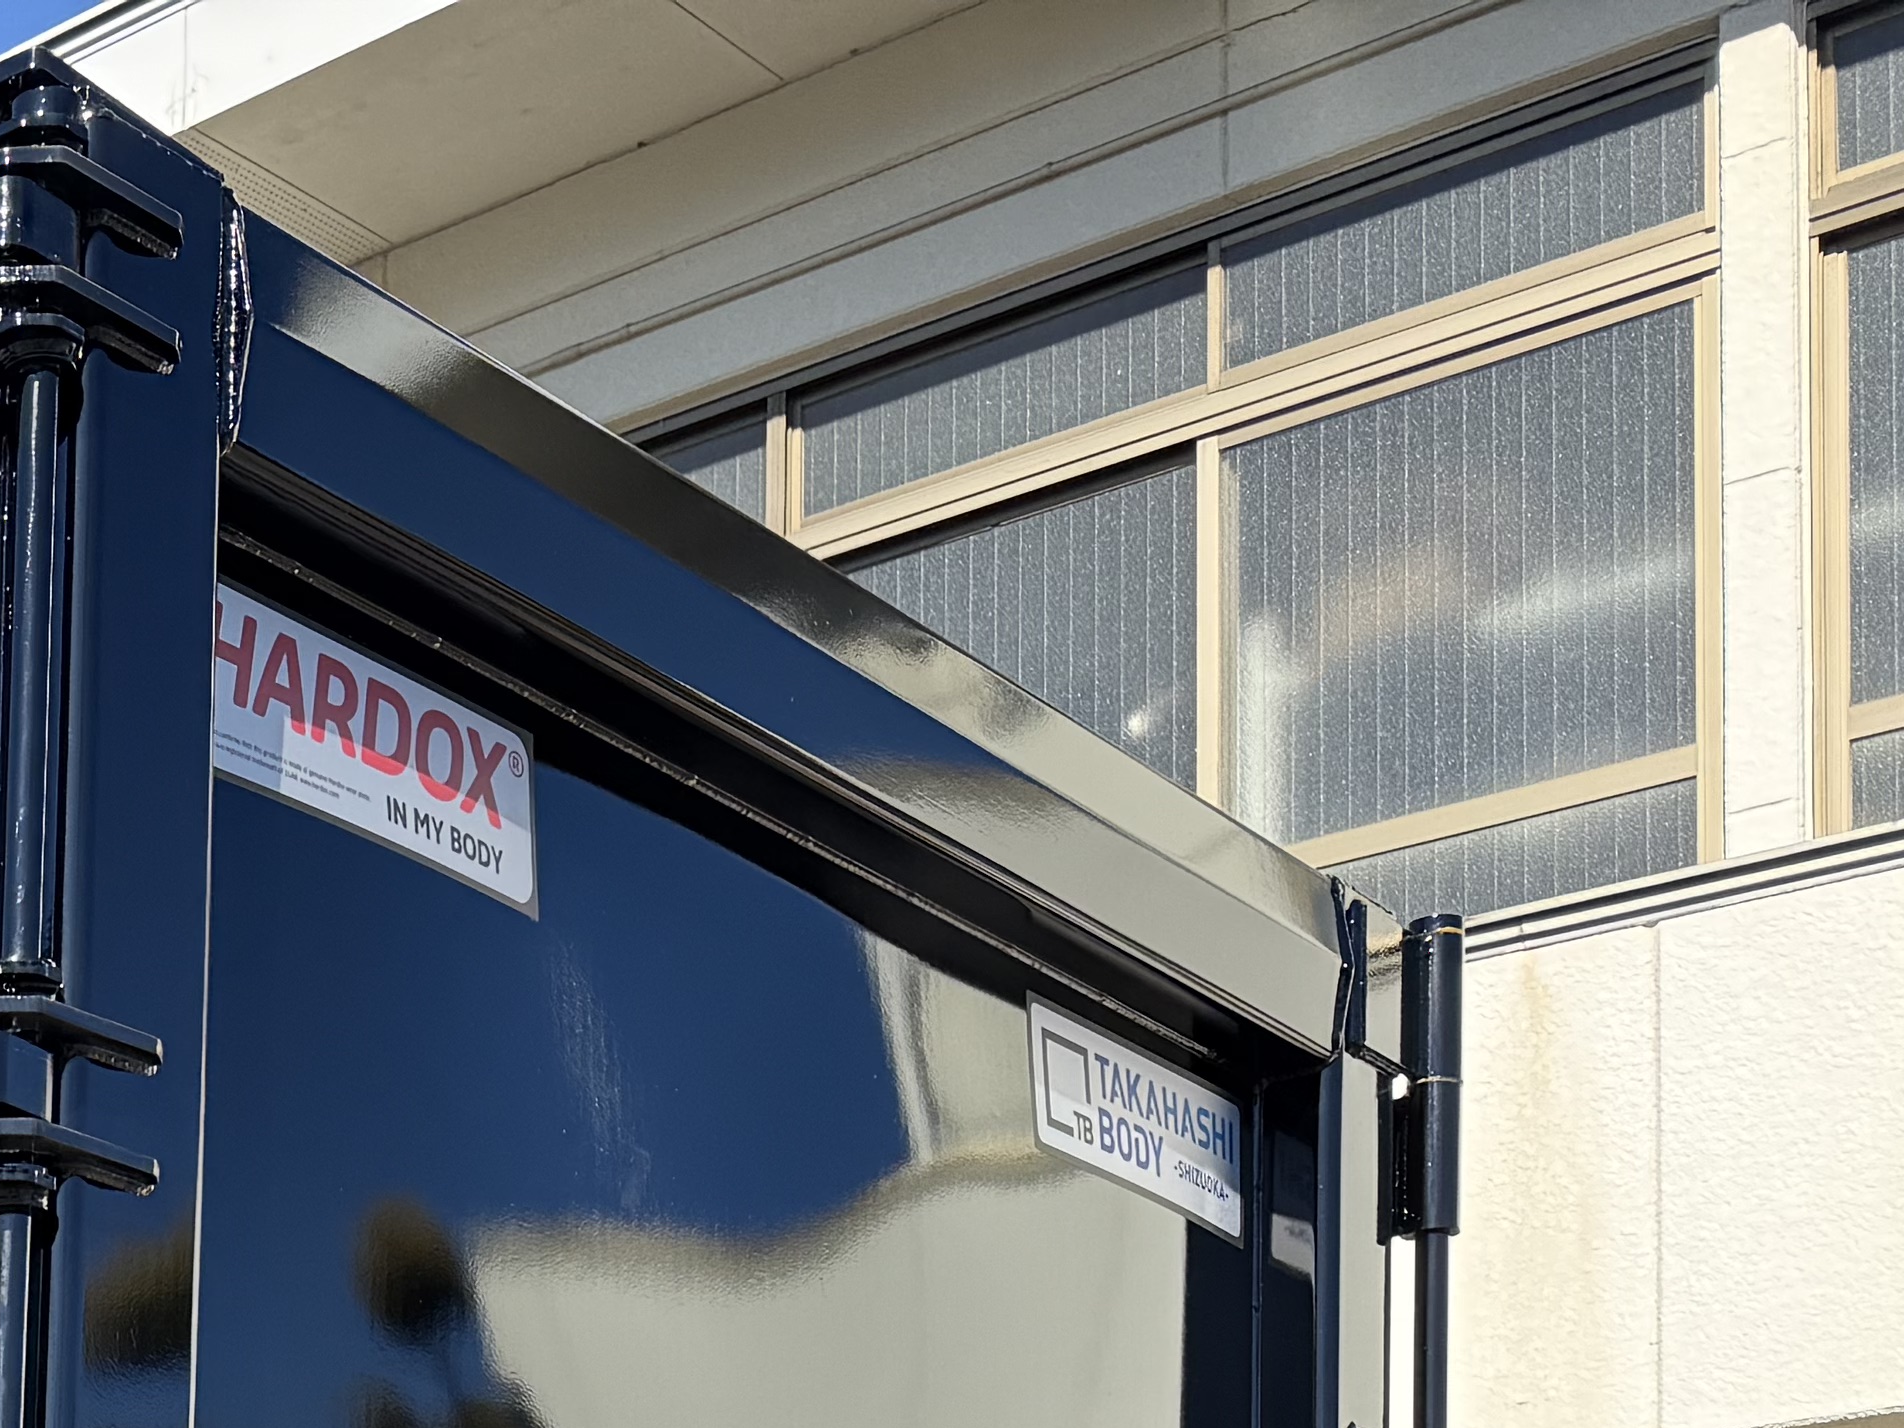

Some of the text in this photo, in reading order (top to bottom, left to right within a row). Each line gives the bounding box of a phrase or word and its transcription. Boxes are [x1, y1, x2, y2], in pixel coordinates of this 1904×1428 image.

[386, 794, 504, 875] IN MY BODY
[1073, 1110, 1095, 1146] TB
[1094, 1052, 1234, 1165] TAKAHASHI
[1097, 1106, 1164, 1178] BODY
